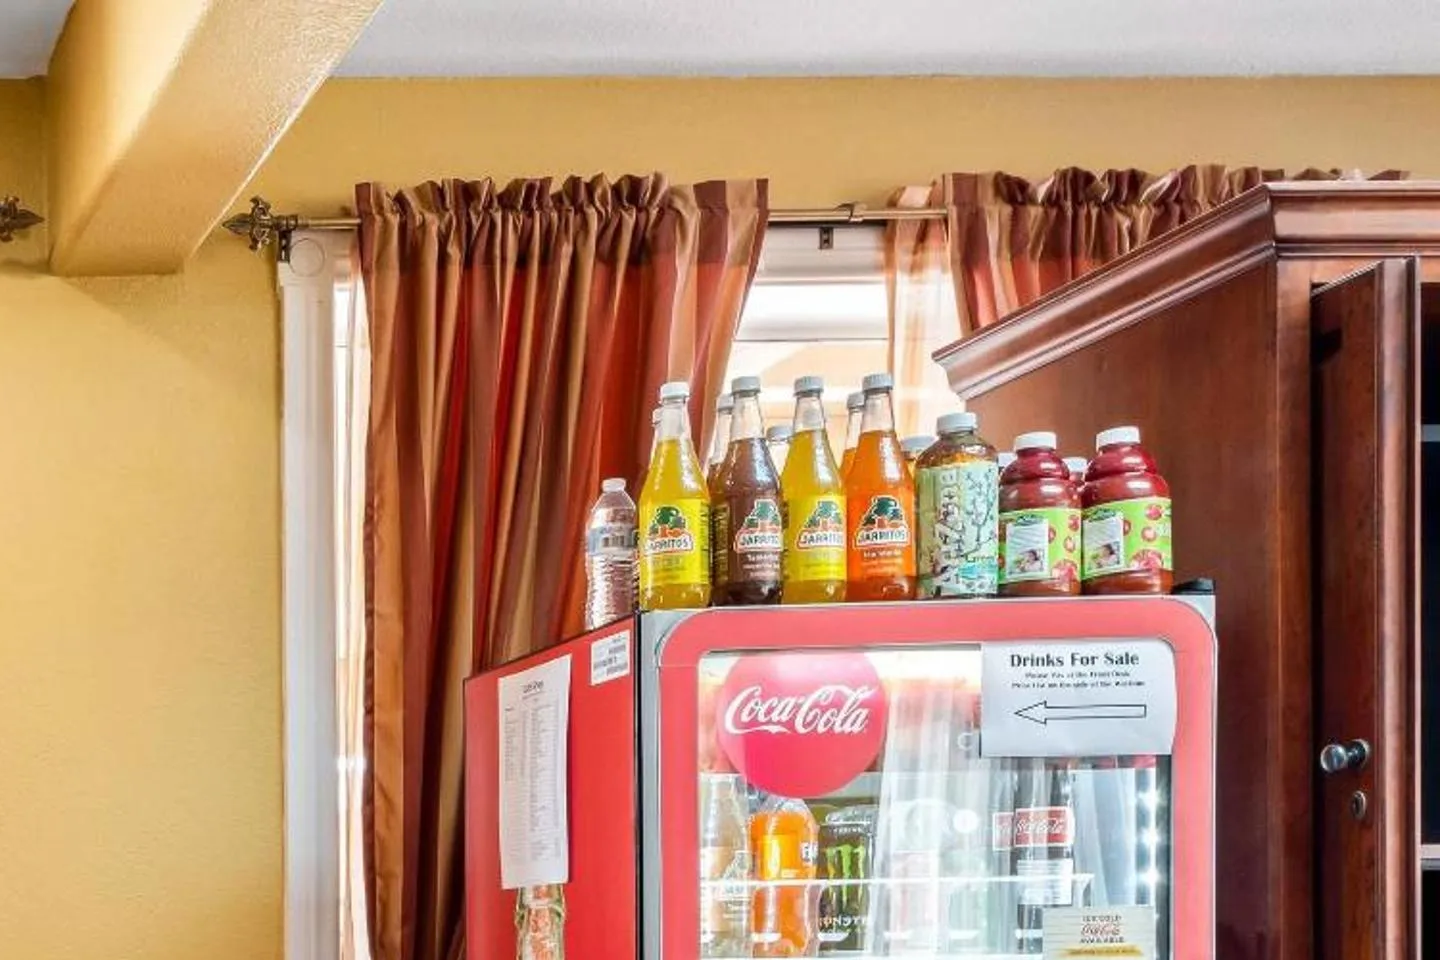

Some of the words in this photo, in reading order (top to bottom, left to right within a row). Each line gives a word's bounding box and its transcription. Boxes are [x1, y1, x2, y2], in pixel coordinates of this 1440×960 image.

[647, 538, 689, 550] ARRITOS
[1011, 653, 1064, 667] Drinks
[1070, 652, 1099, 667] For
[1104, 652, 1139, 666] Sale
